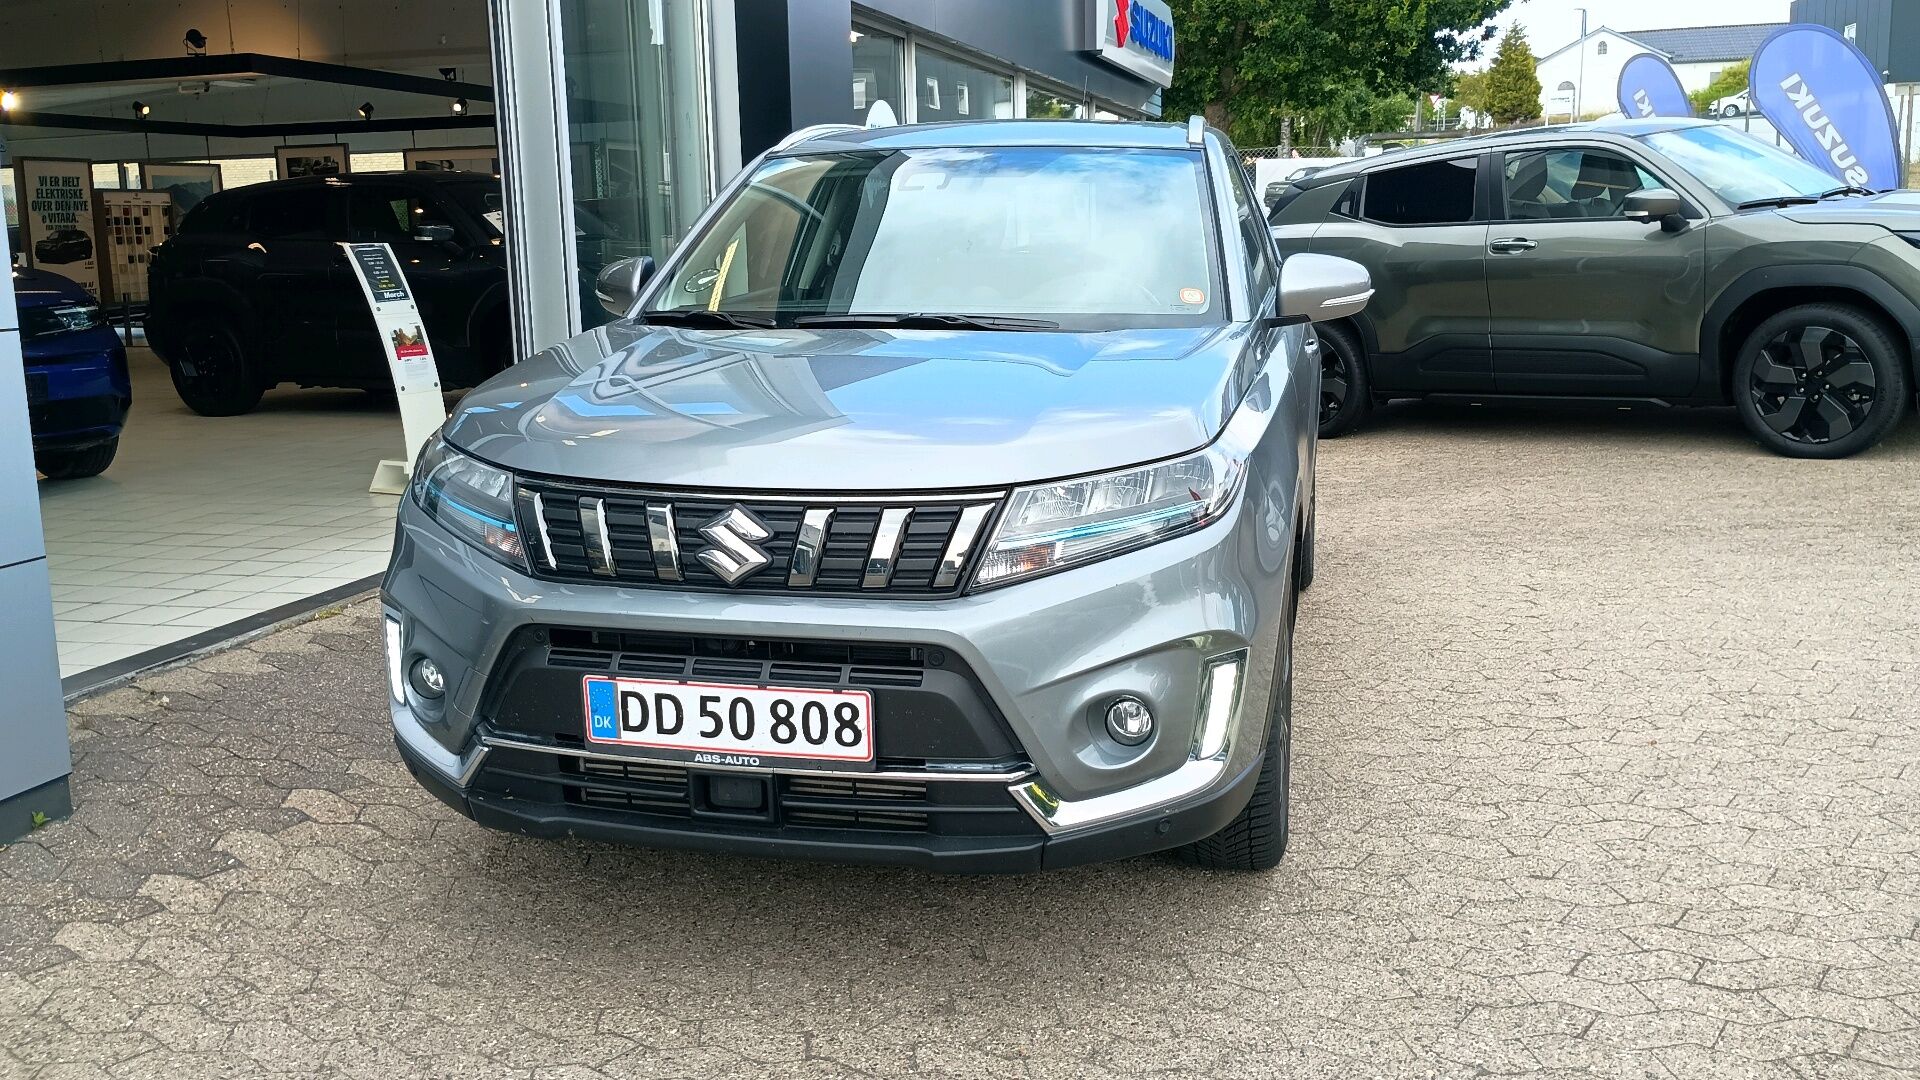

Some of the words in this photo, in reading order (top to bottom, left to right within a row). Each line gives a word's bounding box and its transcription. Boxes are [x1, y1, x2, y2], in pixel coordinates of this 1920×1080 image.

[1130, 0, 1172, 62] SUZUKI
[38, 176, 47, 187] VI
[50, 176, 60, 187] ER
[62, 176, 80, 187] HELT
[36, 188, 83, 199] ELEKTRISKE
[32, 200, 54, 211] OVER
[55, 200, 72, 211] DEN
[73, 200, 88, 211] NYE
[594, 716, 612, 729] DK
[620, 690, 684, 735] DD
[700, 695, 755, 740] 50
[769, 698, 863, 747] 808
[694, 753, 760, 766] ABS-AUTO
